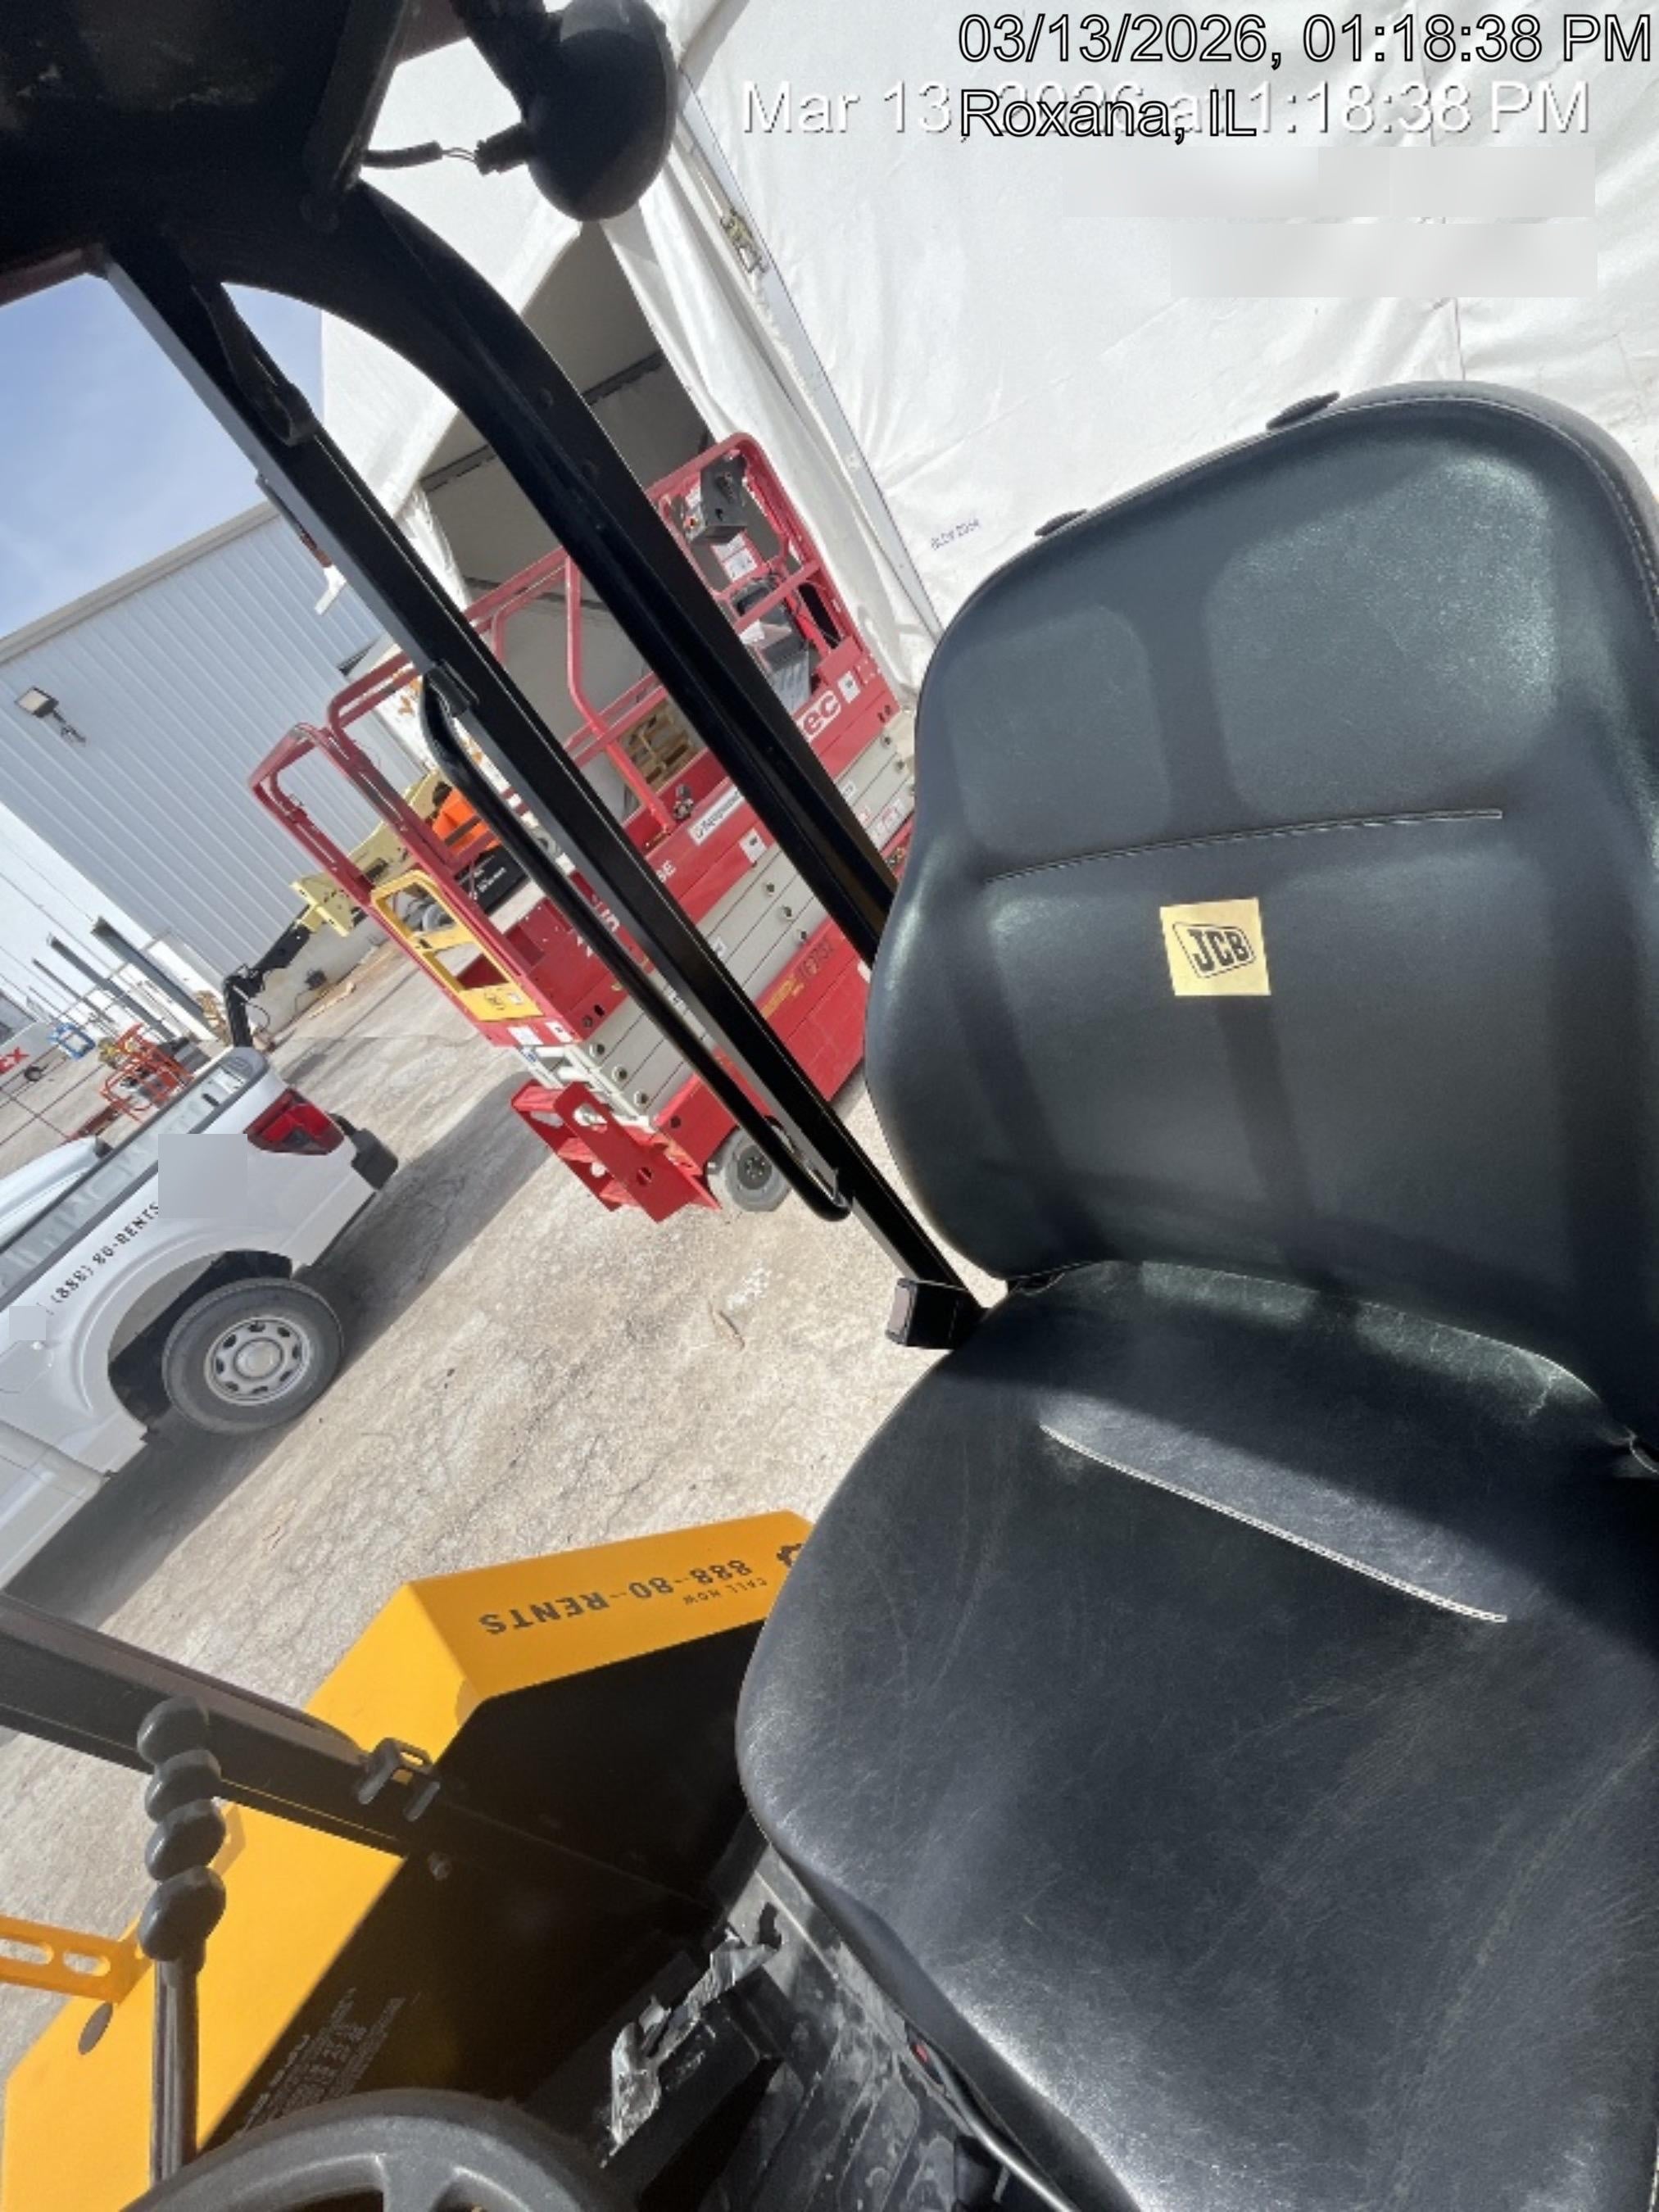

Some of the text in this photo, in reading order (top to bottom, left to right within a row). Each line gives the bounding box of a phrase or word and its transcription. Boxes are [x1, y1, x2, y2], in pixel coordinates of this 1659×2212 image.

[1189, 928, 1249, 972] JCB
[682, 1577, 768, 1606] CALL NOW
